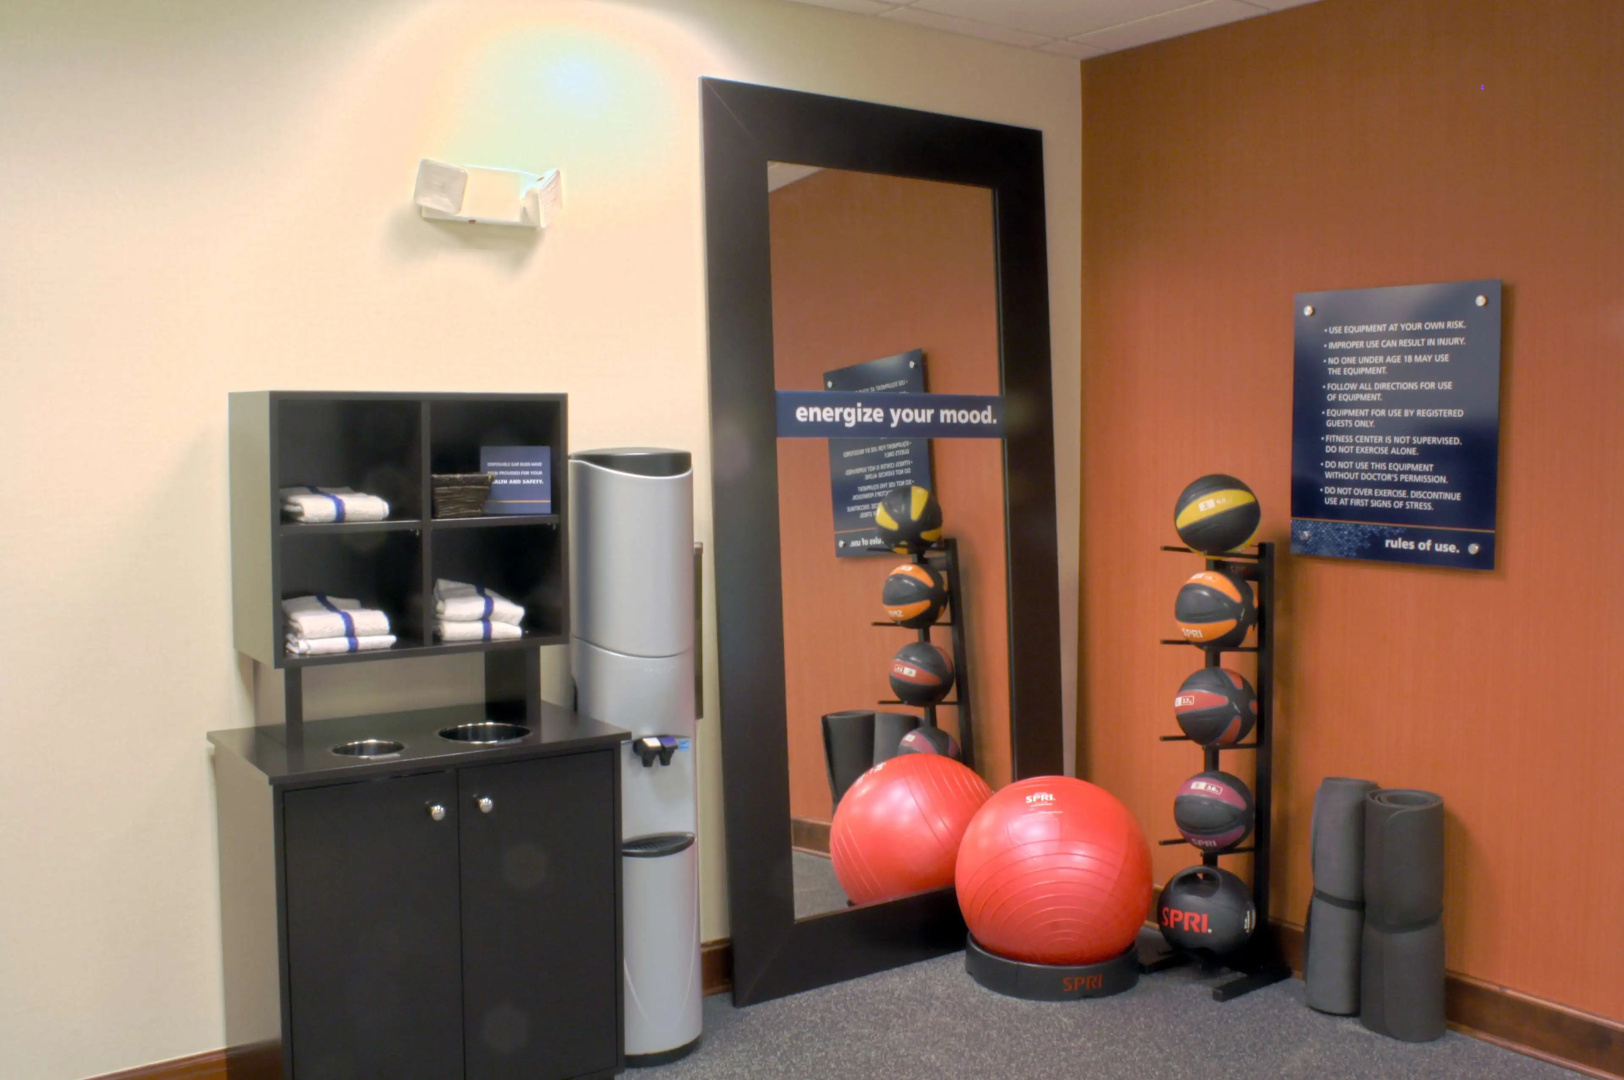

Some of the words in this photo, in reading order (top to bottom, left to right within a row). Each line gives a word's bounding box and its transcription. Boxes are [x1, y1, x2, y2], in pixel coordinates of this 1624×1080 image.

[1329, 326, 1342, 334] USE
[1345, 324, 1387, 333] EQUIPMENT
[1400, 323, 1422, 331] YOUR
[1425, 322, 1444, 330] OWN
[1447, 321, 1466, 329] RISK.
[1329, 341, 1364, 349] IMPROPER
[1366, 340, 1379, 348] USE
[1381, 339, 1397, 347] CAN
[1399, 338, 1425, 347] RESULT
[1427, 338, 1435, 346] IN
[1435, 354, 1449, 362] USE
[1344, 367, 1387, 375] EQUIPMENT.
[1374, 382, 1418, 390] DIRECTIONS
[1339, 393, 1382, 402] EQUIPMENT.
[796, 403, 884, 427] energize
[890, 409, 934, 427] your
[940, 406, 997, 424] mood.
[1327, 409, 1369, 417] EQUIPMENT
[1417, 409, 1463, 417] REGISTERED
[1326, 435, 1353, 443] FITNESS
[1413, 437, 1462, 445] SUPERVISED.
[1338, 461, 1353, 469] NOT
[1371, 462, 1386, 470] THIS
[1389, 463, 1434, 472] EQUIPMENT
[1325, 472, 1359, 480] WITHOUT
[1361, 473, 1398, 481] DOCTOR'S
[1400, 474, 1448, 483] PERMISSION.
[1337, 487, 1352, 495] NOT
[1354, 488, 1372, 496] OVER
[1375, 489, 1408, 498] EXERCISE.
[1411, 491, 1461, 500] DISCONTINUE
[1325, 497, 1337, 505] USE
[1351, 498, 1368, 506] FIRST
[1371, 500, 1391, 508] SIGNS
[1394, 501, 1403, 509] OF
[1405, 502, 1433, 510] STRESS.
[1385, 538, 1414, 549] rules
[1418, 540, 1431, 550] of
[1435, 542, 1459, 553] use.
[1182, 628, 1203, 638] SPRI
[1191, 838, 1217, 847] SPRI
[1062, 974, 1102, 991] SPRI
